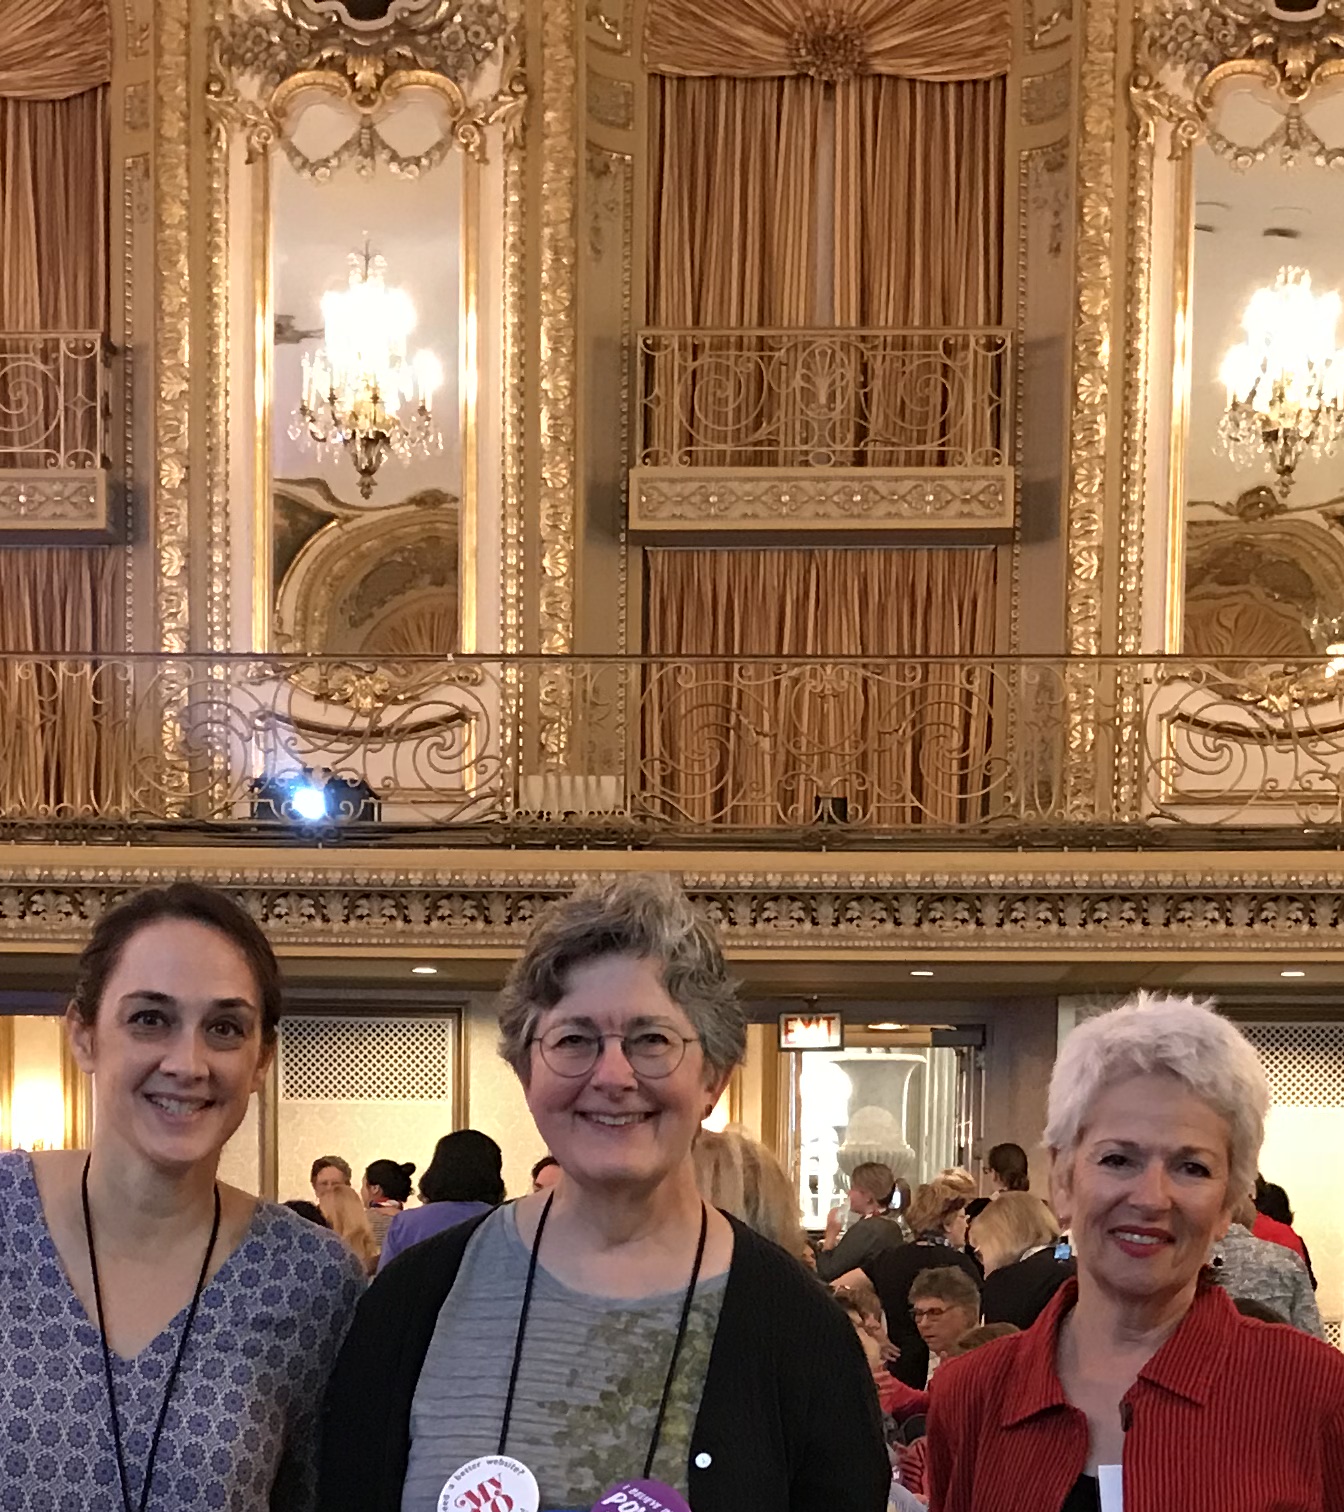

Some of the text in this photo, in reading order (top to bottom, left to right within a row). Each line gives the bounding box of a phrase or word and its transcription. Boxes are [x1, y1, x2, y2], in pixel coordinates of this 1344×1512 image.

[454, 1462, 481, 1480] better
[486, 1458, 525, 1476] website?
[454, 1472, 503, 1508] MY
[628, 1488, 662, 1509] BELIEVE
